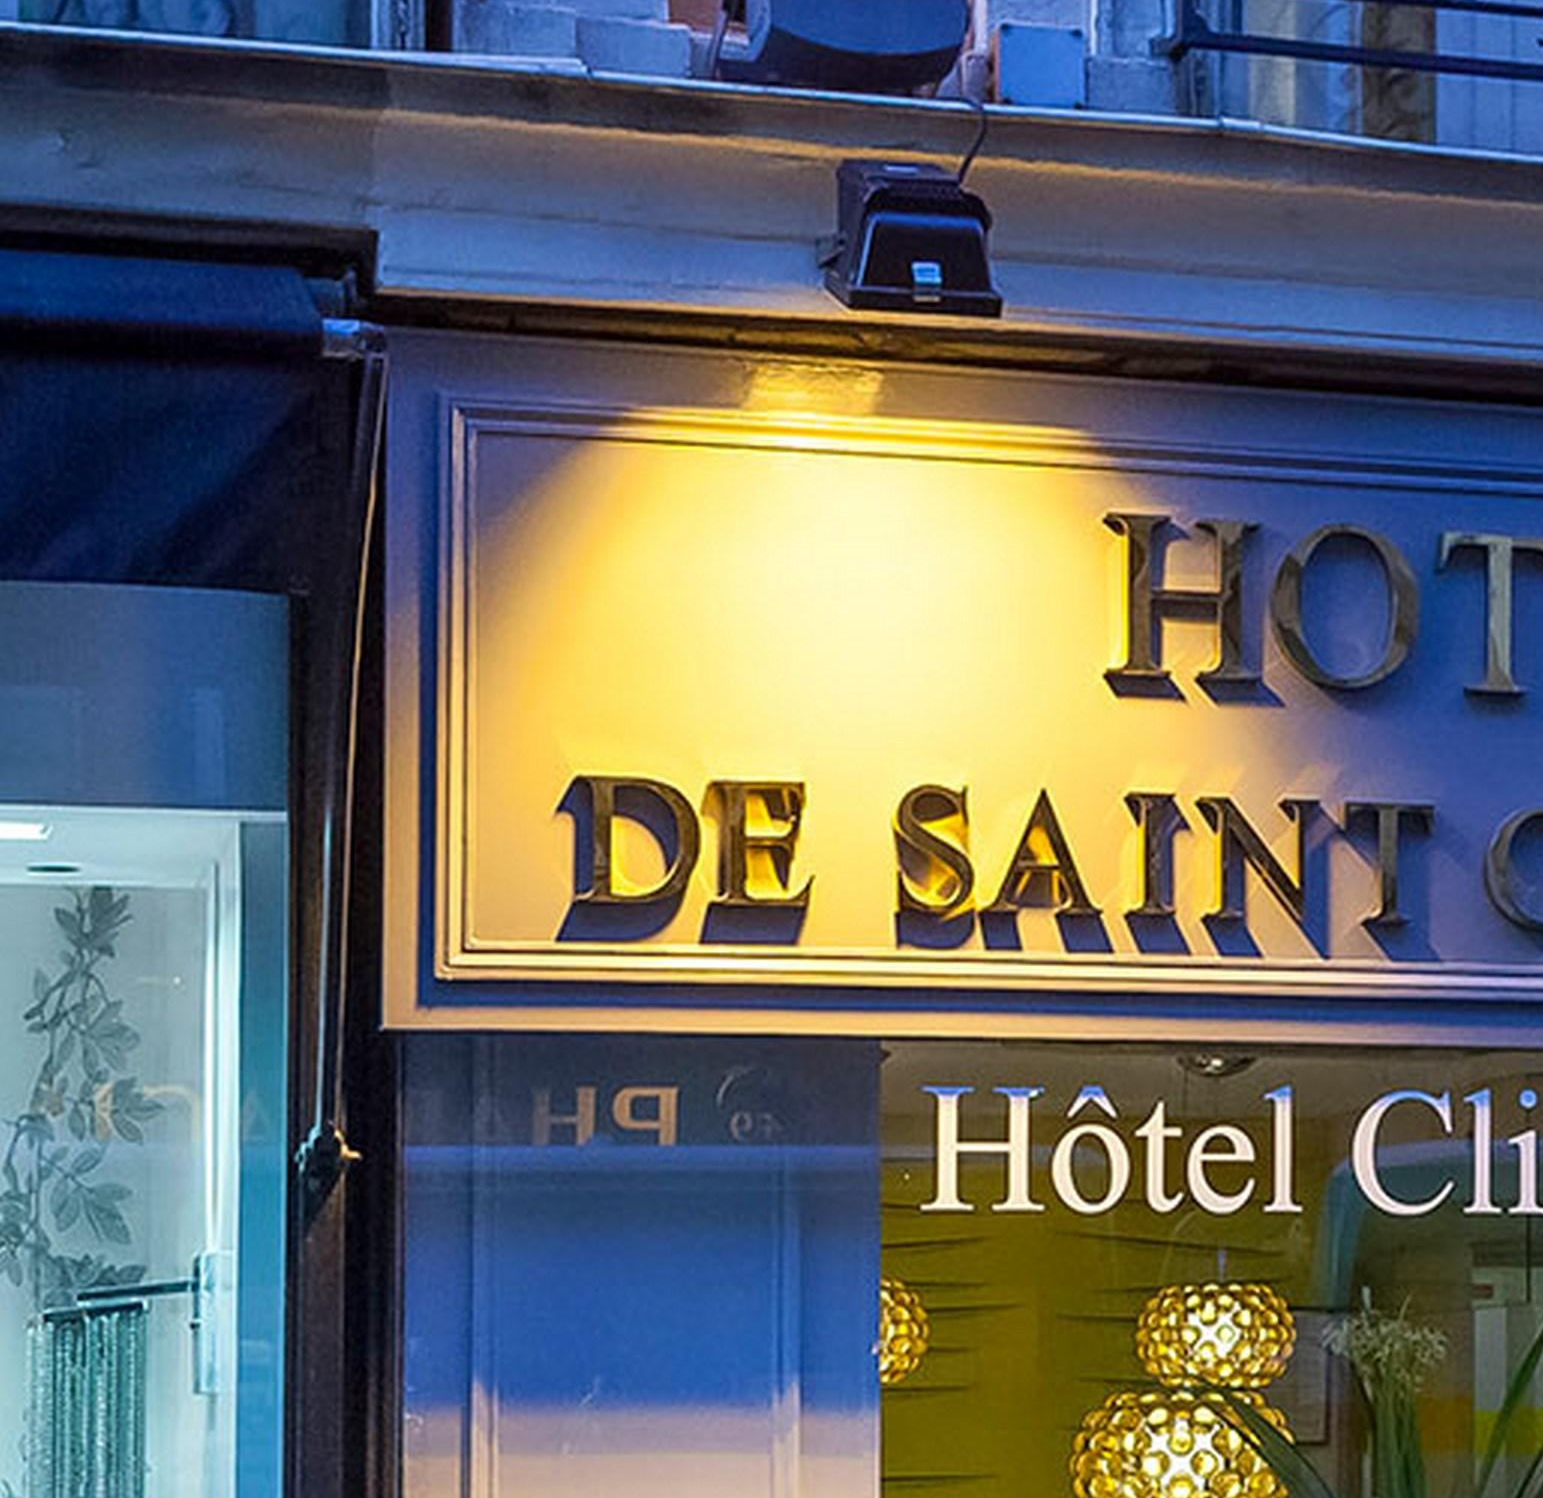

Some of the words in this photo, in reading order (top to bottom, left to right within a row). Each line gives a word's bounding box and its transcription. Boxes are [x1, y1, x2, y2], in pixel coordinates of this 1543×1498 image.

[564, 774, 816, 910] DE
[892, 783, 1436, 928] SAINT
[919, 1085, 1303, 1215] Hôtel
